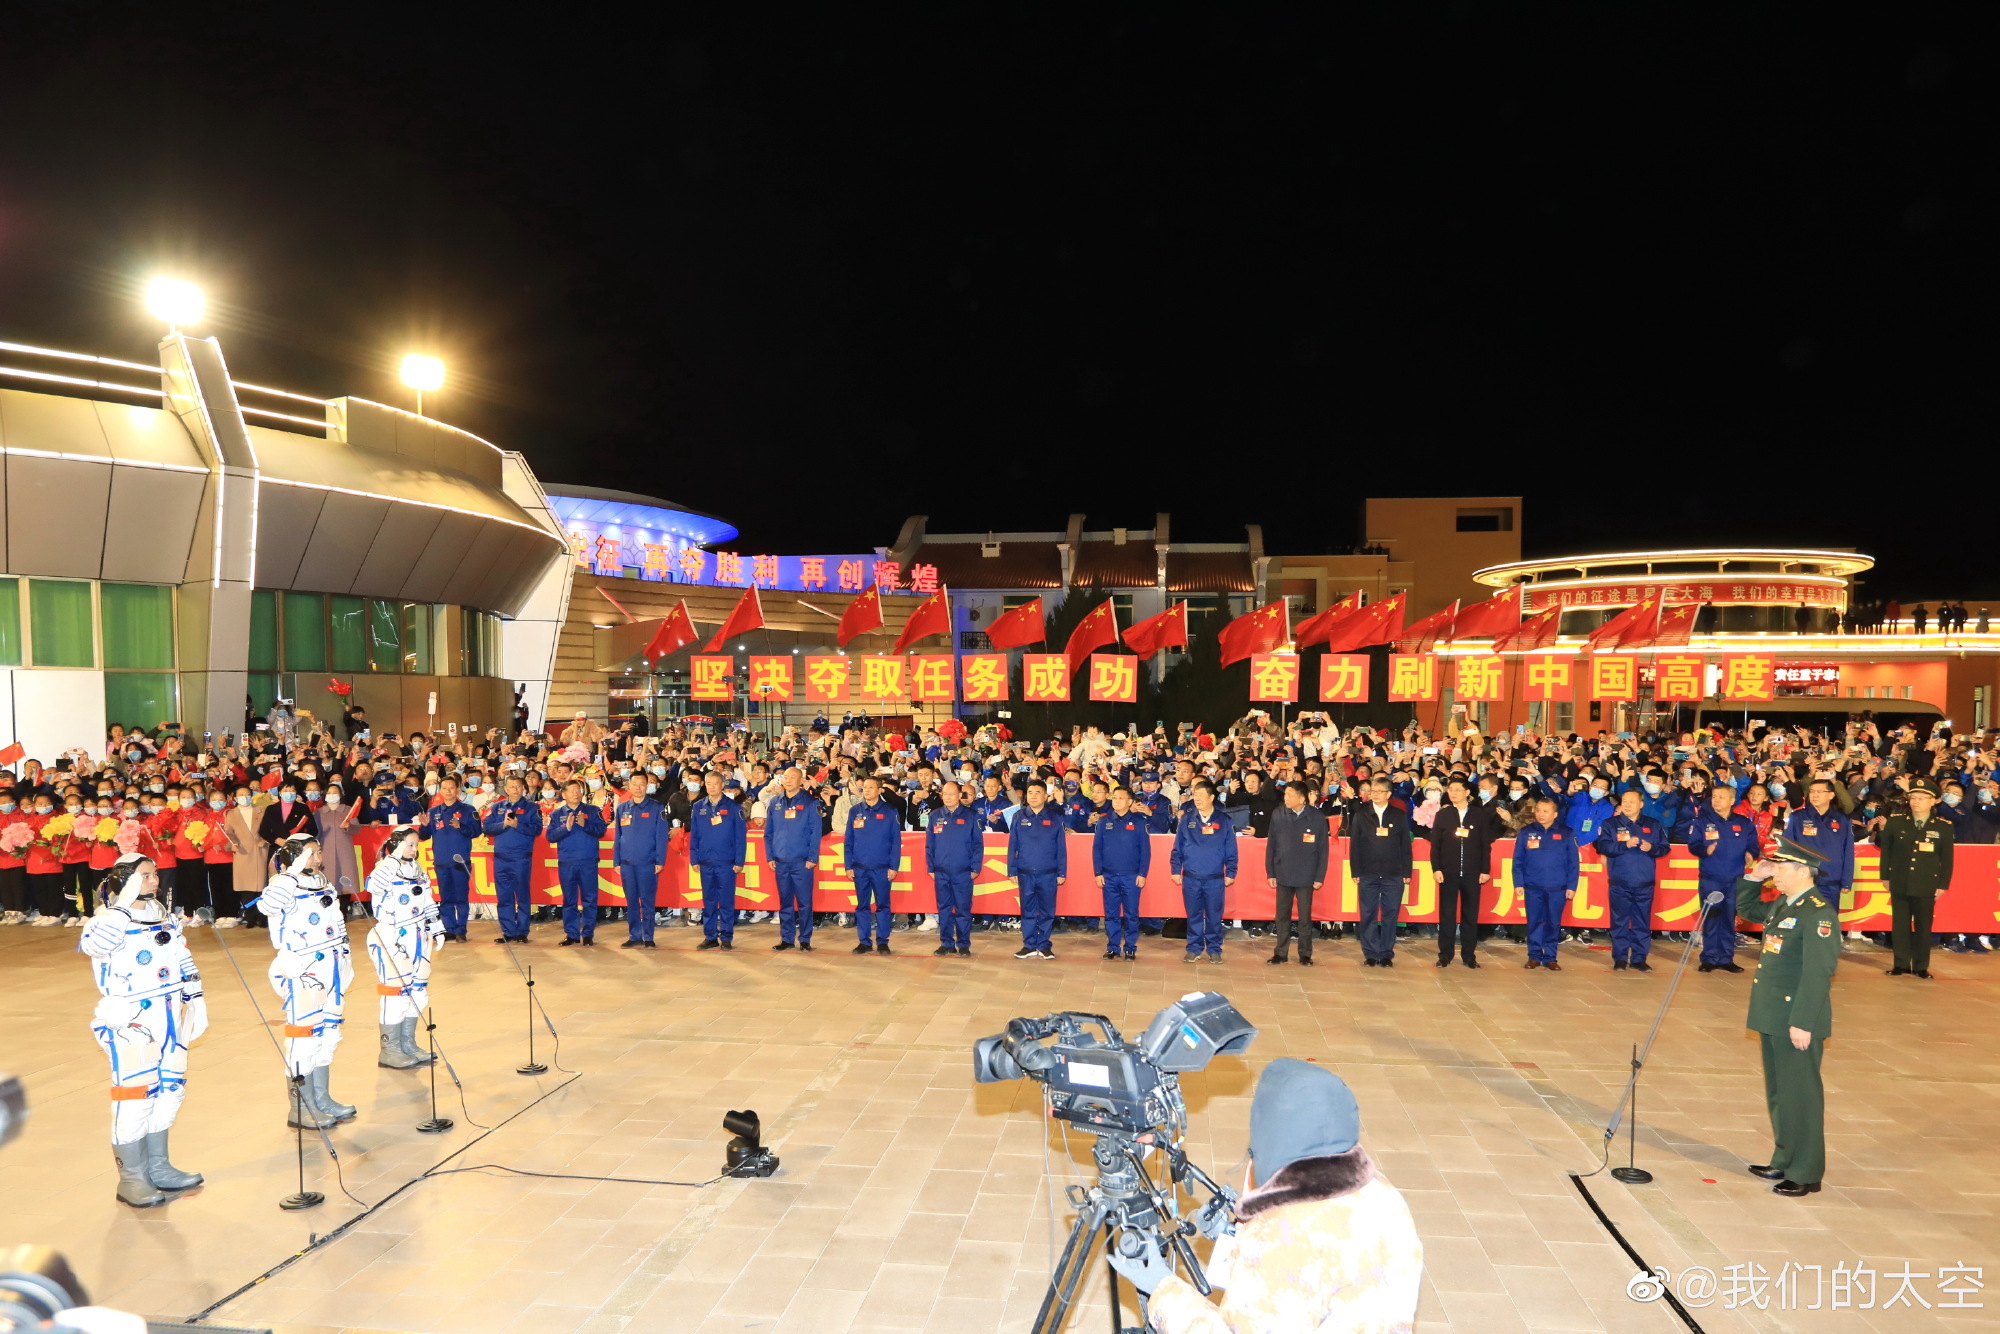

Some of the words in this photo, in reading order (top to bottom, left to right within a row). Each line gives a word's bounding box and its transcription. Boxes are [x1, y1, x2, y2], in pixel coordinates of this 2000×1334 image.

[643, 543, 778, 585] 再夺胜利
[800, 557, 939, 593] 再创辉煌
[695, 657, 1134, 699] 坚决夺取任务成功
[1254, 655, 1774, 699] 奋力刷新中国高度
